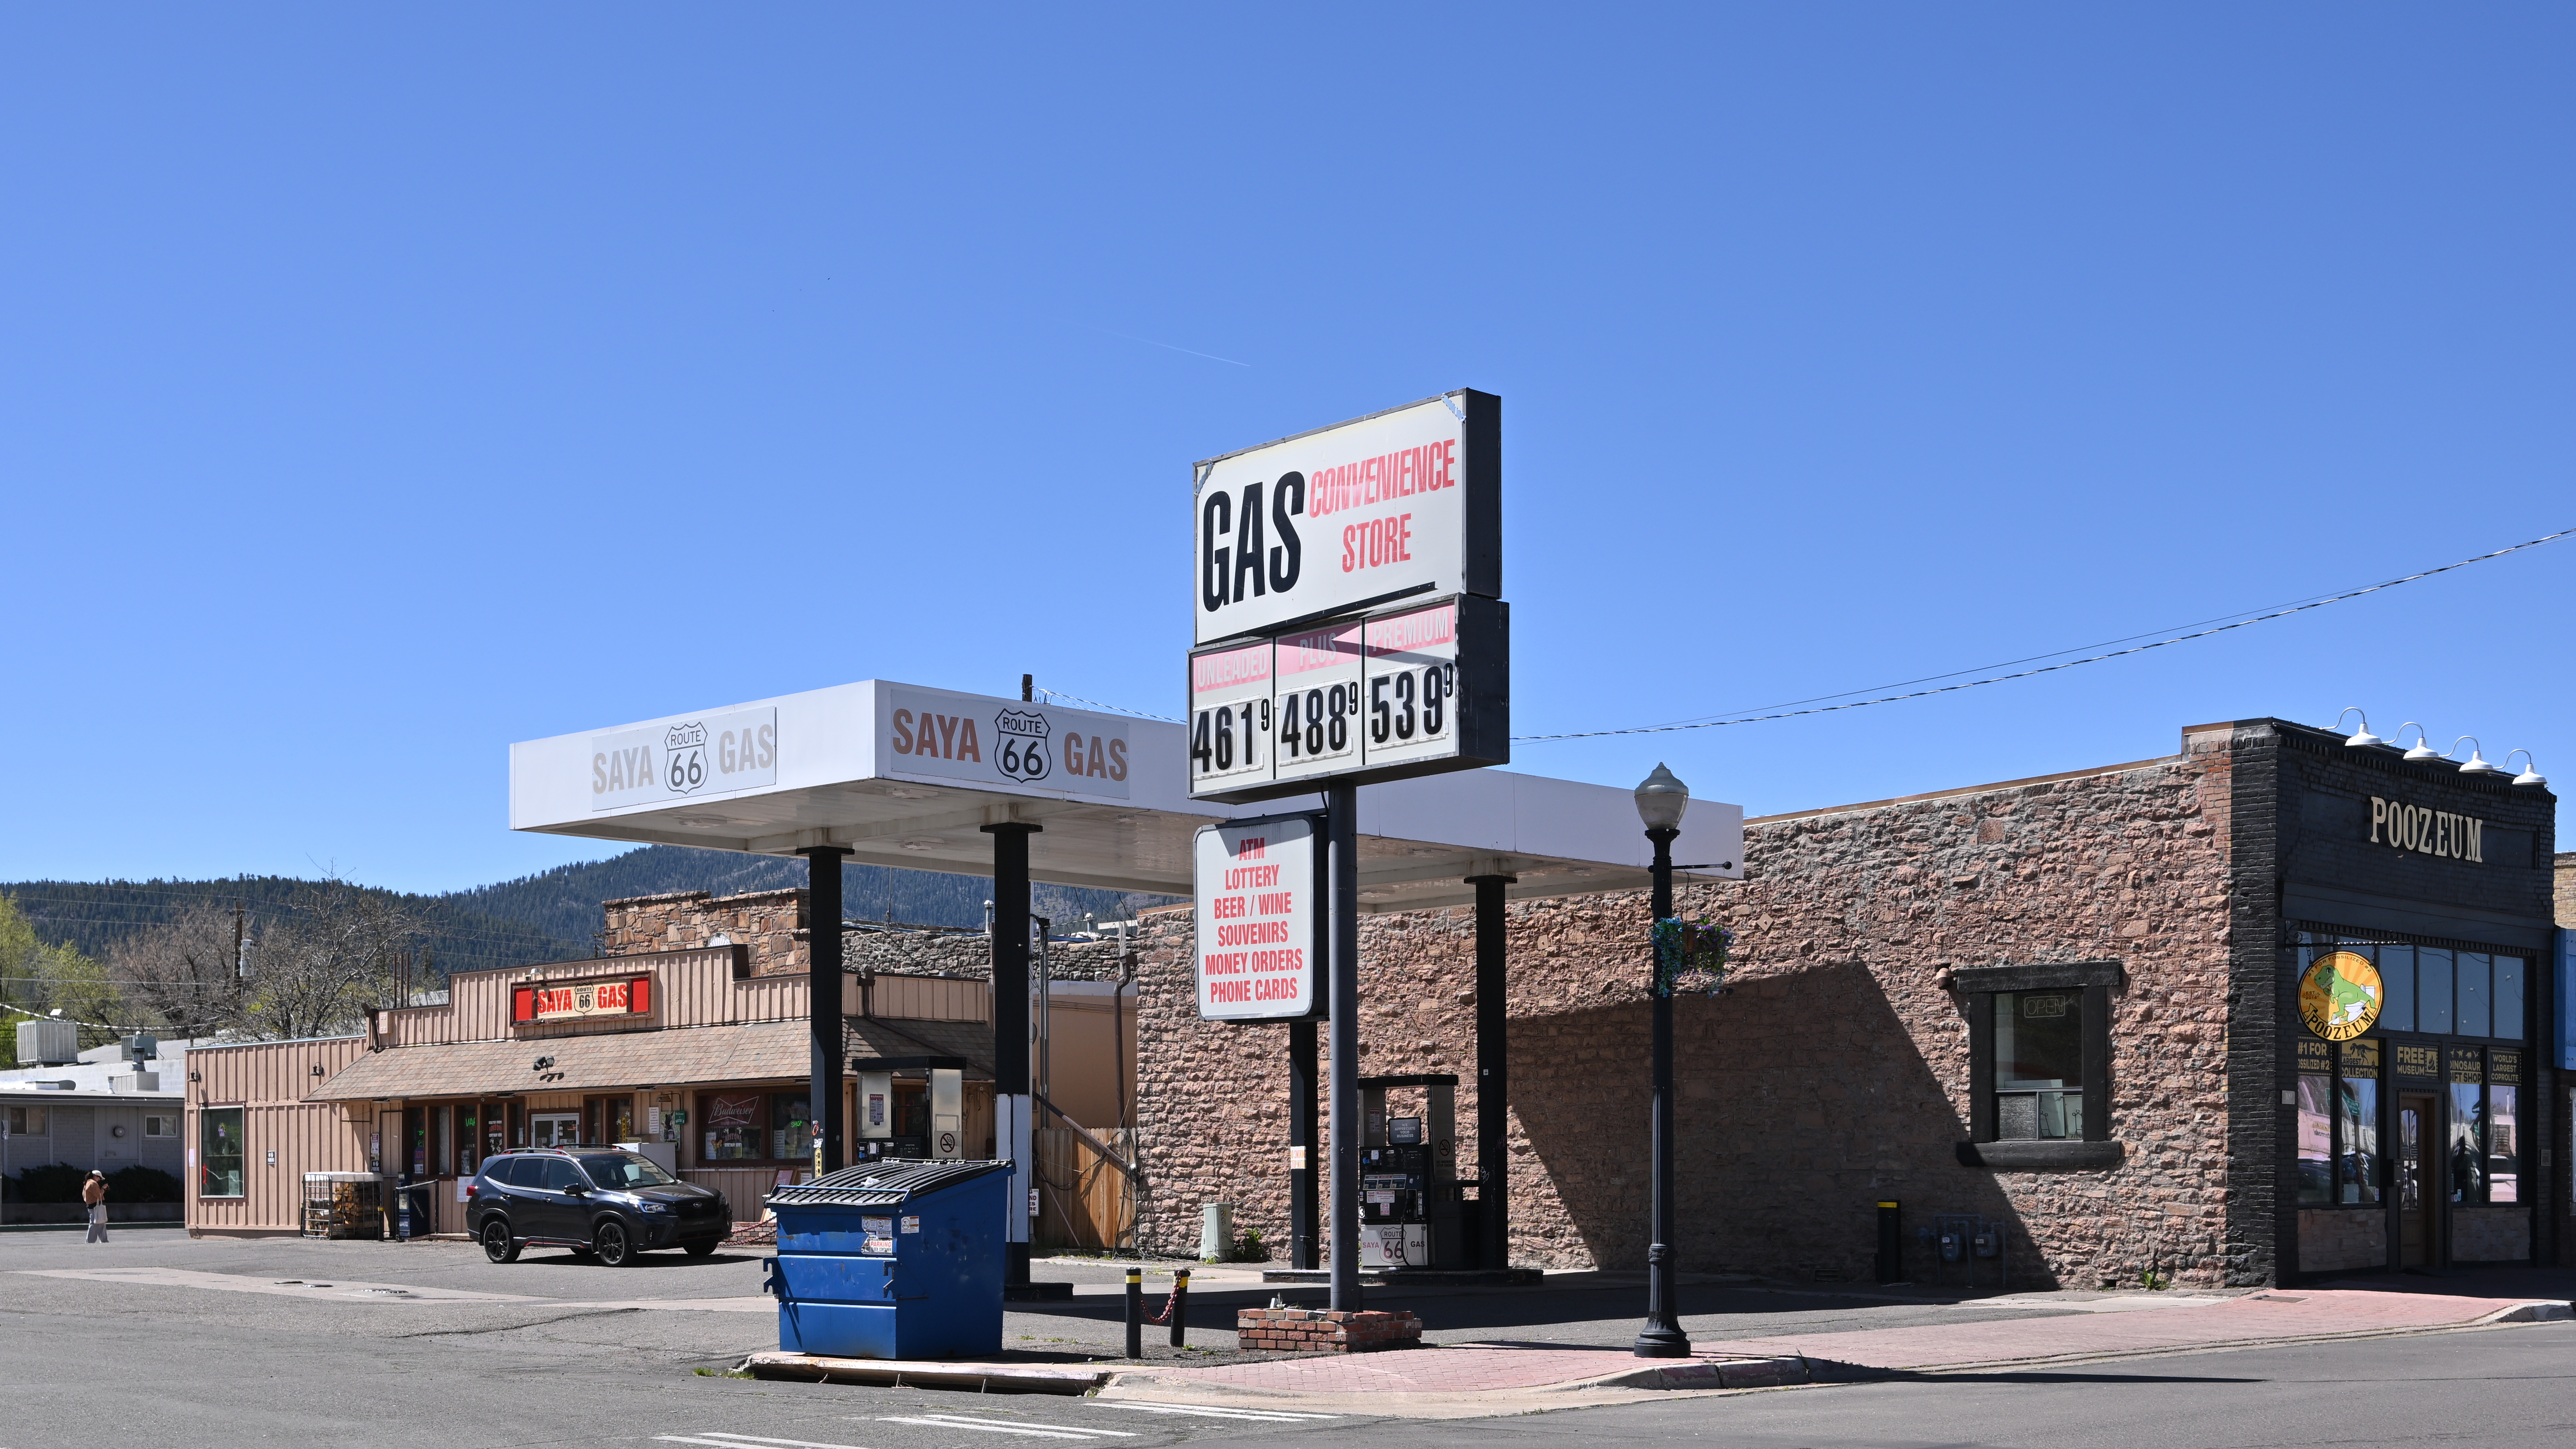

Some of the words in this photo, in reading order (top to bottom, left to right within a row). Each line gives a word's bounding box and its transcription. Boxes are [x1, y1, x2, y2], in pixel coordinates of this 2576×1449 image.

[1202, 471, 1305, 613] GAS
[1309, 439, 1455, 518] CONVENIENCE
[1342, 513, 1412, 573] STORE
[1373, 609, 1448, 652] PREMIUM
[1299, 631, 1337, 667] PLUS
[1196, 647, 1268, 688] UNLEADED
[892, 708, 981, 763] SAYA
[1003, 716, 1043, 734] ROUTE
[670, 730, 701, 747] ROUTE
[719, 724, 773, 775] GAS
[671, 750, 702, 787] 66
[1003, 738, 1043, 775] 66
[1064, 732, 1128, 781] GAS
[593, 745, 655, 794] SAYA
[2370, 796, 2483, 864] POOZEUM
[1238, 837, 1265, 861] ATM
[1225, 864, 1280, 890] LOTTERY
[1214, 896, 1246, 920] BEER
[1258, 892, 1292, 915] WINE
[1218, 920, 1289, 947] SOUVENIRS
[1205, 952, 1248, 975] MONEY
[1252, 948, 1303, 973] ORDERS
[2315, 959, 2327, 969] FOR
[2328, 955, 2364, 965] FOSSILIZED
[538, 989, 573, 1014] SAYA
[579, 994, 590, 1009] 66
[598, 984, 628, 1009] GAS
[1210, 980, 1251, 1003] PHONE
[1255, 977, 1297, 1001] CARDS
[2026, 997, 2064, 1015] OPEN
[2306, 1011, 2375, 1040] POOZEUM
[2298, 1042, 2308, 1055] #1
[2309, 1042, 2327, 1056] FOR
[2397, 1046, 2424, 1064] FREE
[2493, 1054, 2517, 1063] WORLD'S
[2320, 1059, 2330, 1070] #2
[2397, 1064, 2425, 1075] MUSEUM
[2491, 1072, 2519, 1081] COPROLITE
[2493, 1063, 2517, 1072] LARGEST
[2463, 1072, 2481, 1083] SHOP
[712, 1103, 754, 1116] Budweiser
[725, 1133, 742, 1142] ARIZONA
[1359, 1207, 1364, 1217] 3
[1384, 1240, 1403, 1259] 66
